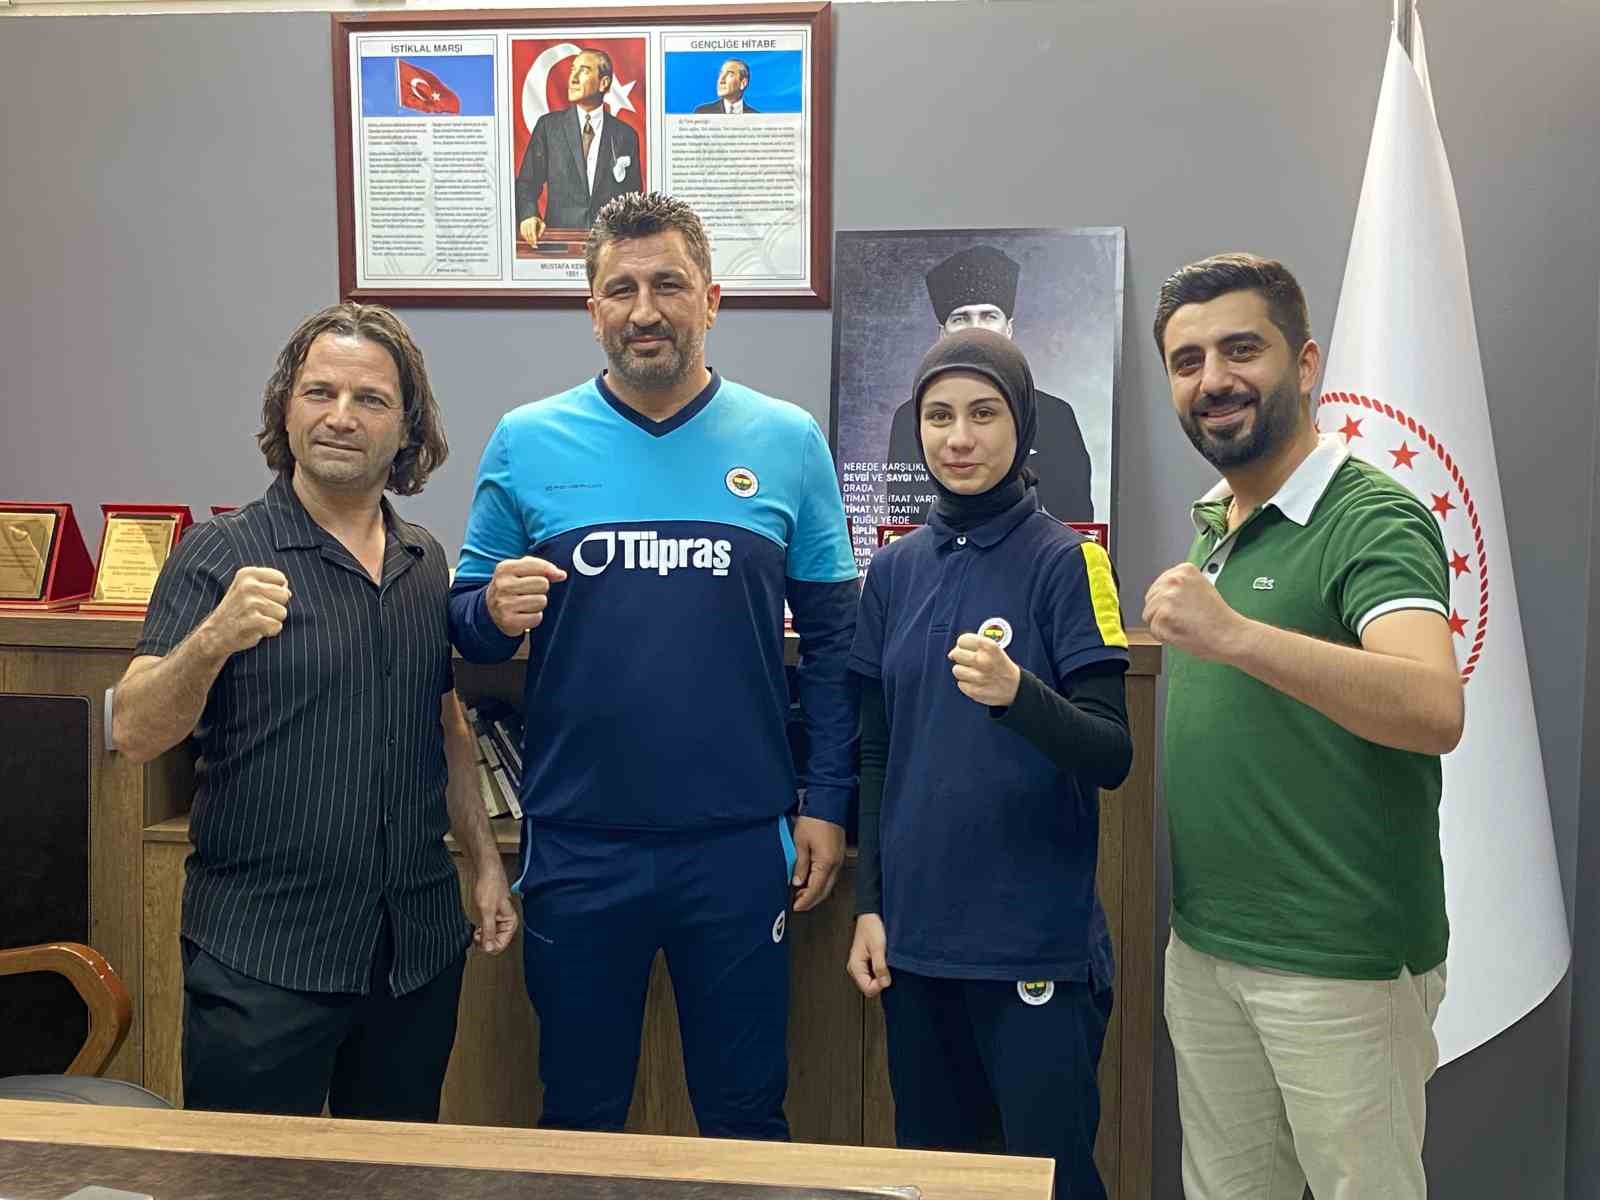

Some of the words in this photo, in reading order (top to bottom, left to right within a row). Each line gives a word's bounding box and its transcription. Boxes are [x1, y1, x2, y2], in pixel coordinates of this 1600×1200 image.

[391, 43, 432, 53] İSTİKLAL
[741, 38, 776, 49] HİTABE
[843, 462, 879, 472] NEREDE
[882, 462, 926, 473] KARŞILIKL
[843, 471, 869, 482] SEVGİ
[871, 473, 884, 482] VE
[886, 473, 912, 482] SAYGI
[843, 484, 874, 493] ORADA
[873, 495, 887, 504] VE
[873, 506, 886, 515] VE
[881, 516, 911, 525] YERDE
[618, 531, 732, 576] Tüpraş
